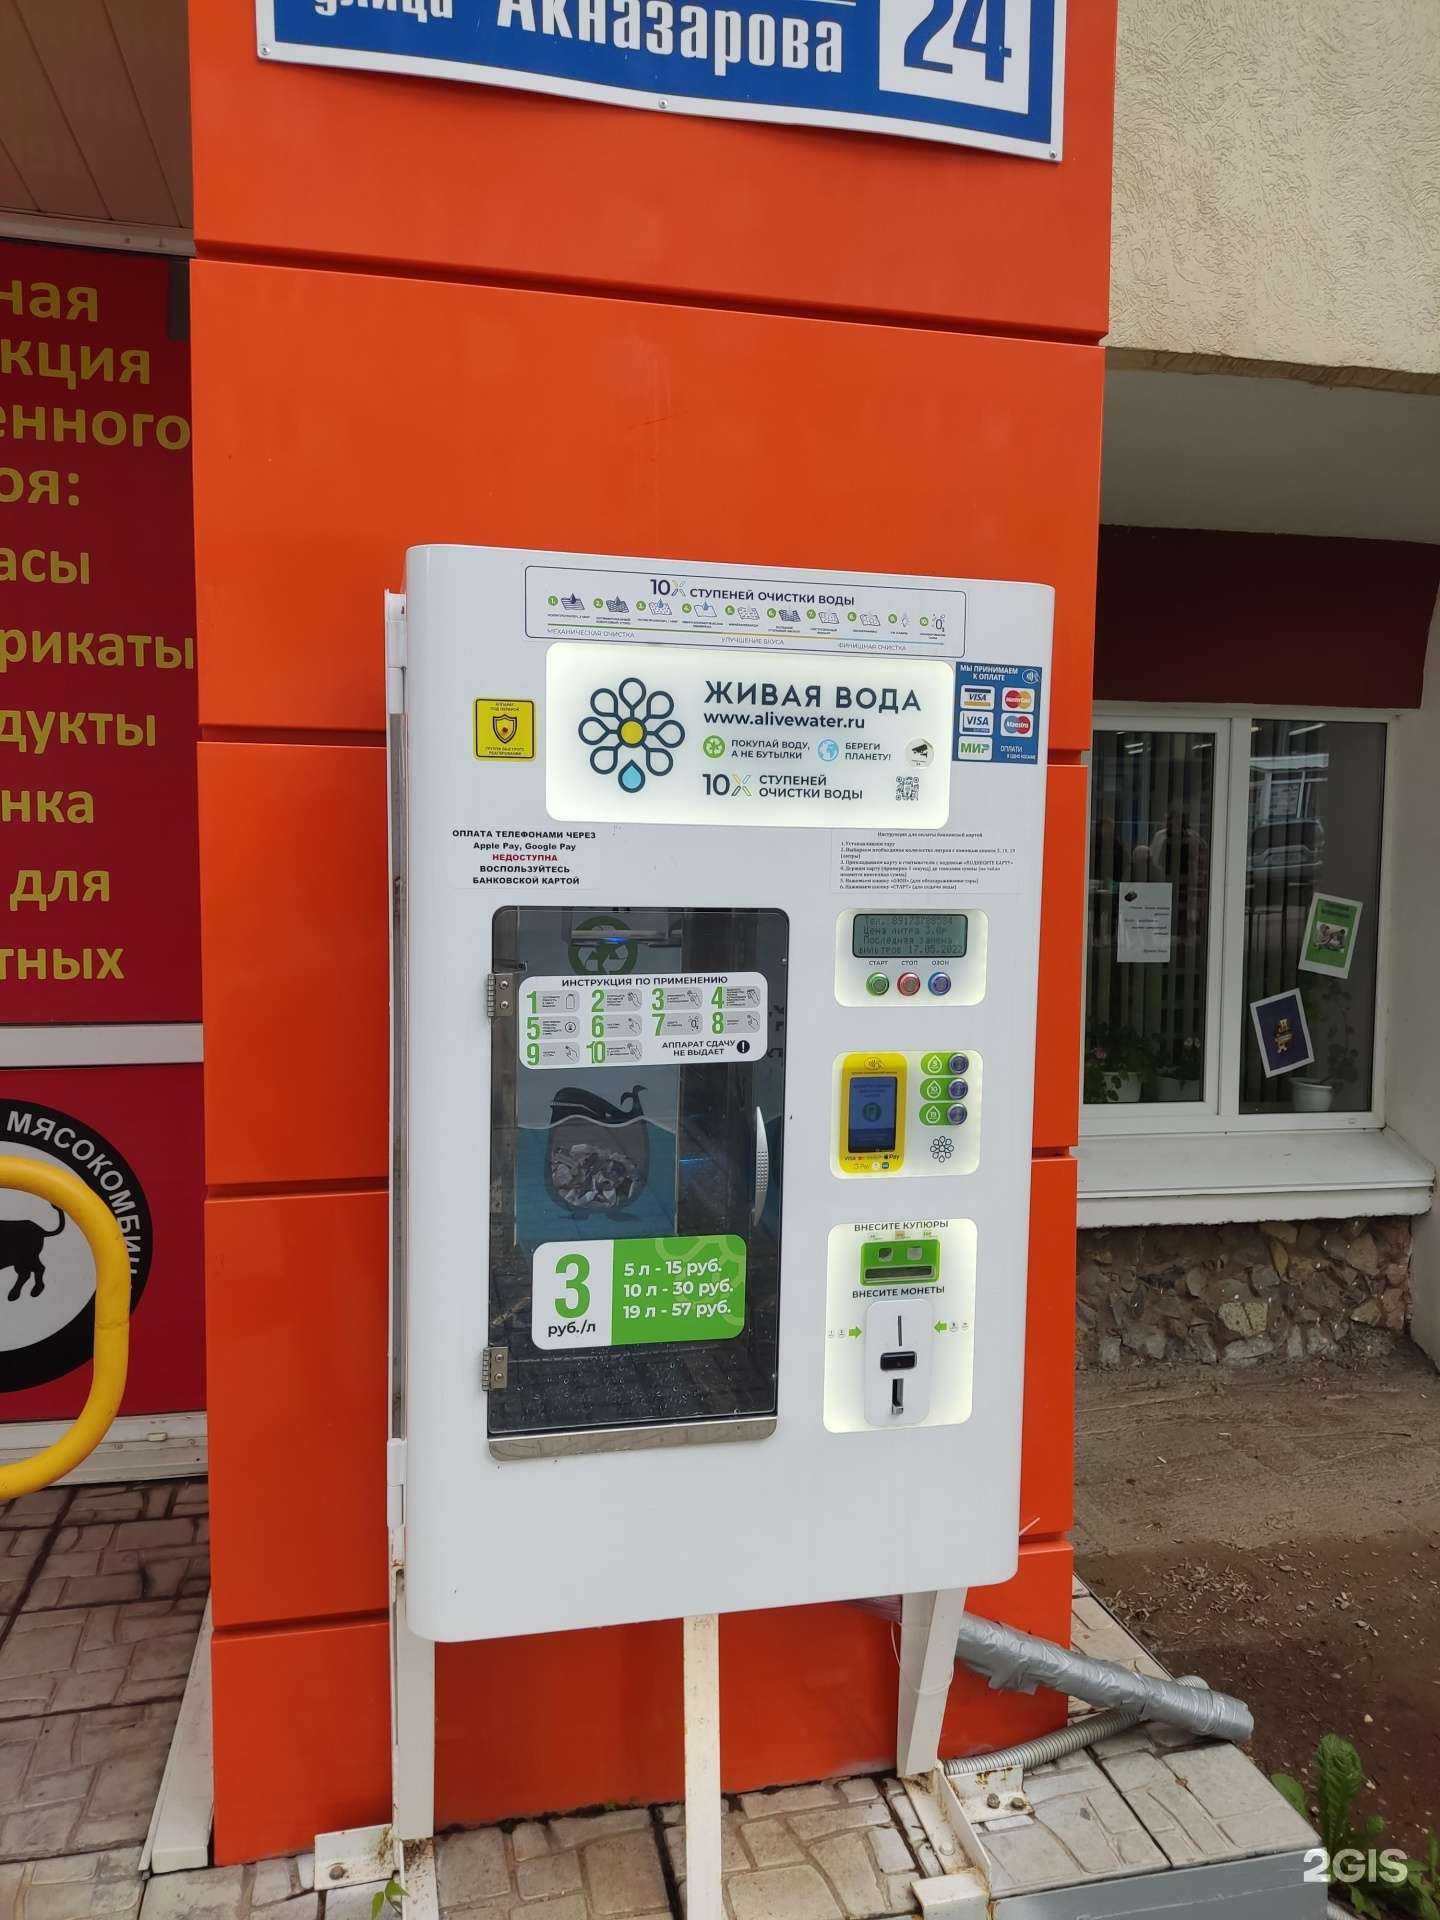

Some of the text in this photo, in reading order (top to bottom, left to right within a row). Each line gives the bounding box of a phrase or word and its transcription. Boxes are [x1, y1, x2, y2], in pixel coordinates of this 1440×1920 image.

[904, 0, 1013, 83] 24
[0, 339, 151, 390] кция
[0, 405, 191, 450] нного
[690, 587, 754, 601] СТУПЕНЕЙ
[758, 591, 815, 604] ОЧИСТКИ
[819, 595, 855, 606] ВОДЫ
[0, 628, 194, 674] рикаты
[704, 680, 921, 713] ЖИВАЯ ВОДА
[703, 711, 865, 729] www.alivewater.ru
[966, 715, 989, 726] VISA
[0, 708, 156, 755] дукты
[731, 738, 810, 752] ПОКУПАЙ ВОДУ,
[845, 741, 881, 751] БЕРЕГИ
[960, 742, 990, 754] МИР
[731, 750, 802, 760] А НЕ БУТЫЛКИ
[845, 752, 891, 762] ПЛАНЕТУ!
[759, 773, 828, 787] СТУПЕНЕЙ
[759, 787, 864, 801] ОЧИСТКИ ВОДЫ
[0, 789, 94, 824] нка
[452, 829, 597, 839] ОПЛАТА ТЕЛЕФОНАМИ ЧЕРЕЗ
[473, 842, 576, 852] Apple Pay, Google Pay
[492, 854, 558, 862] НЕДОСТУПНА
[480, 864, 570, 873] ВОСПОЛЬЗУЙТЕСЬ
[472, 876, 580, 885] БАНКОВСКОЙ КАРТОЙ
[9, 869, 110, 912] для
[562, 976, 728, 988] ИНСТРУКЦИЯ ПО ПРИМЕНЕНИЮ
[527, 991, 538, 1014] 1
[591, 989, 605, 1012] 2
[651, 988, 665, 1010] 3
[711, 986, 725, 1009] 4
[527, 1017, 541, 1040] 5
[591, 1015, 605, 1038] 6
[651, 1013, 665, 1036] 7
[711, 1011, 725, 1034] 8
[586, 1040, 606, 1064] 10
[662, 1039, 736, 1049] АППАРАТ СДАЧУ
[673, 1048, 724, 1057] НЕ ВЫДАЕТ
[527, 1043, 540, 1065] 9
[854, 1220, 949, 1232] ВНЕСИТЕ КУПЮРЫ
[623, 1263, 635, 1277] 5
[639, 1265, 650, 1276] л
[666, 1260, 682, 1274] 15
[686, 1258, 722, 1277] руб.
[554, 1253, 591, 1319] 3
[623, 1284, 642, 1298] 10
[645, 1285, 657, 1297] л
[672, 1281, 694, 1296] 30
[698, 1278, 734, 1297] руб.
[852, 1285, 945, 1299] ВНЕСИТЕ МОНЕТЫ
[622, 1305, 641, 1319] 19
[644, 1307, 656, 1319] л
[671, 1303, 691, 1316] 57
[696, 1300, 732, 1318] руб.
[548, 1319, 596, 1337] руб./л
